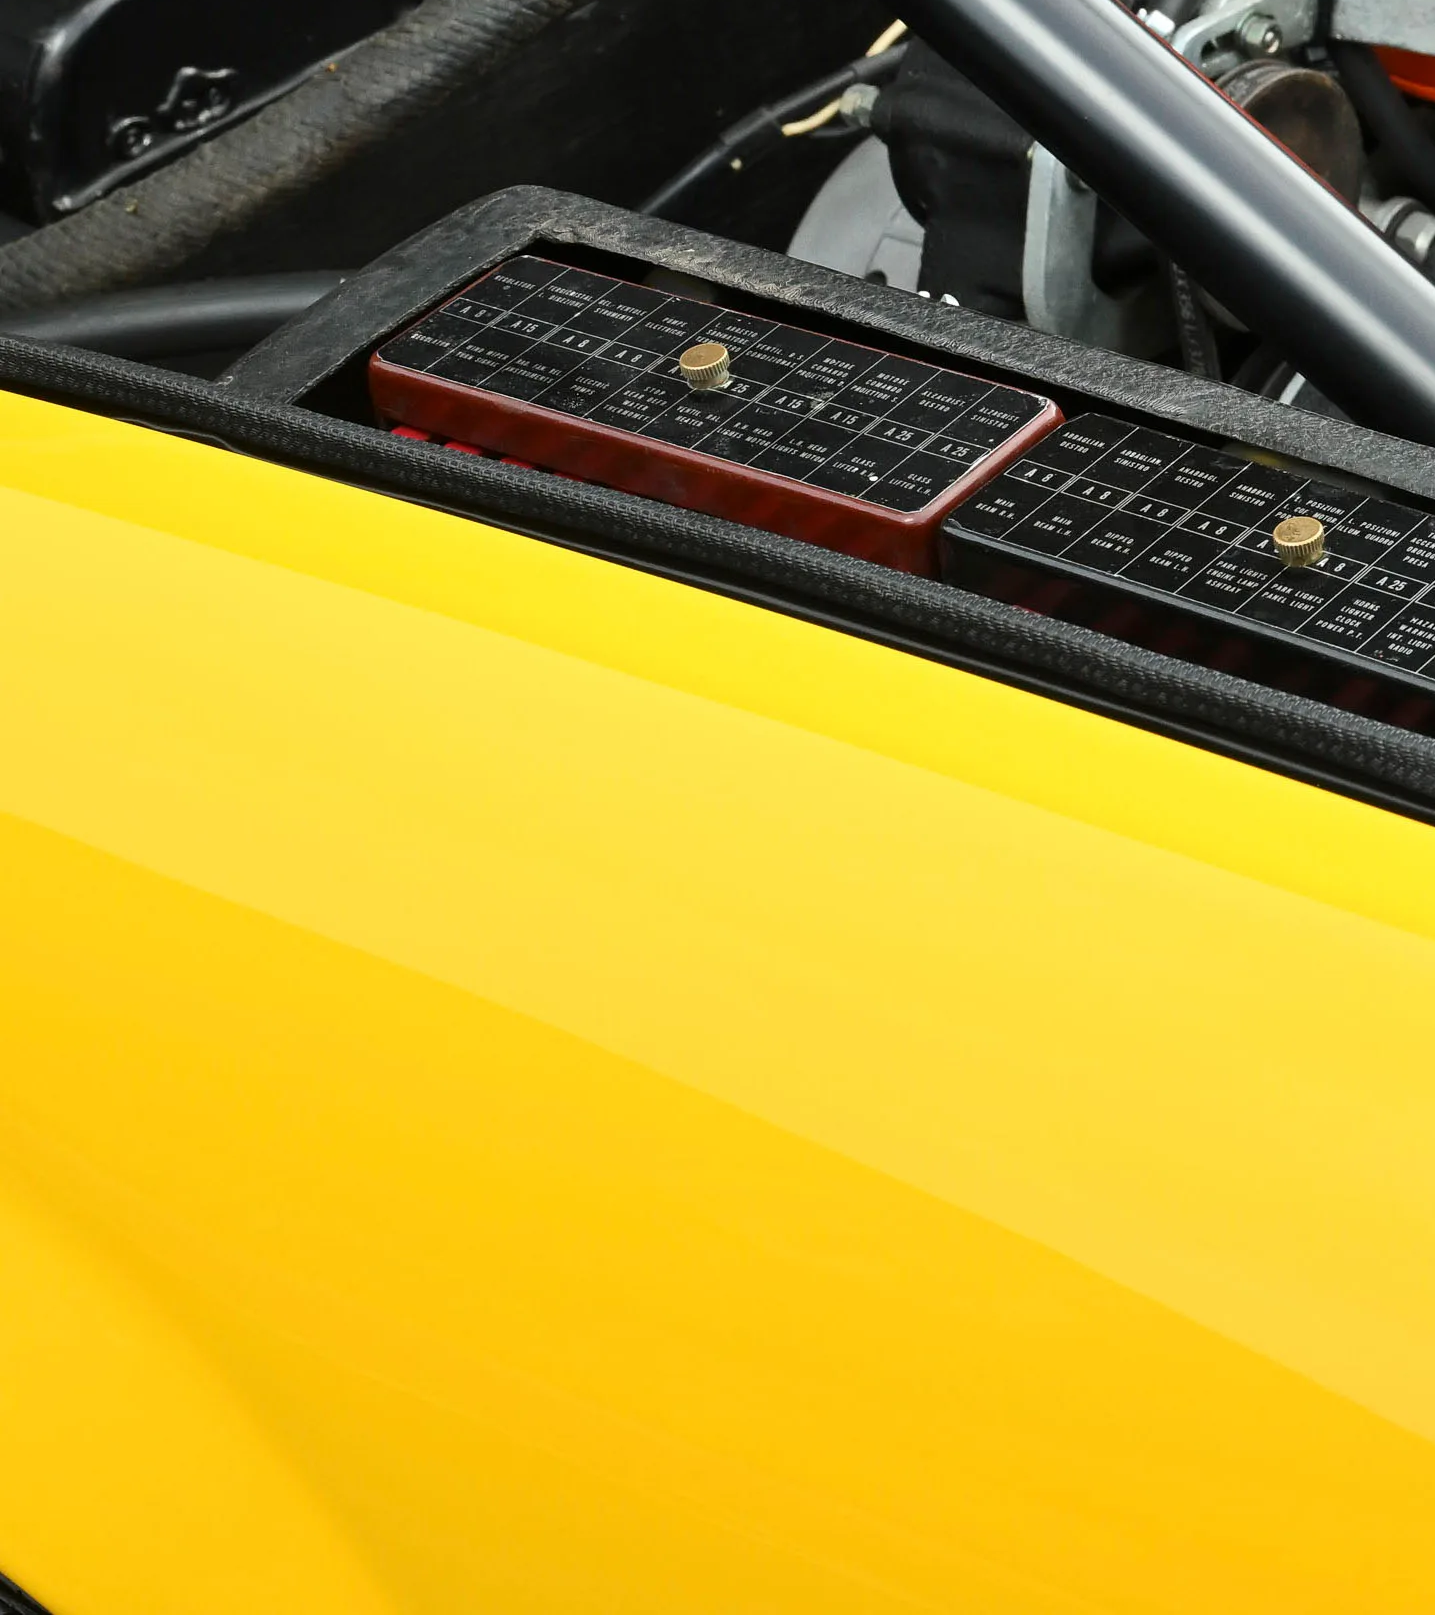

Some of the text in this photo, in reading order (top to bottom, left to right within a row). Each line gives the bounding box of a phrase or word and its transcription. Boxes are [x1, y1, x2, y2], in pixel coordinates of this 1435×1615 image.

[459, 305, 486, 317] A 8
[509, 320, 538, 332] A 15
[562, 335, 589, 347] A 8
[614, 349, 642, 362] A 8
[666, 364, 682, 374] A
[822, 357, 854, 369] MOTORE
[810, 364, 848, 377] COMANDO
[876, 372, 909, 385] MOTORE
[643, 386, 665, 395] STOP
[718, 379, 749, 393] A 25
[850, 385, 890, 400] PROIETTORI
[865, 379, 902, 393] COMANDO
[622, 399, 648, 411] WATER
[774, 395, 803, 408] A 15
[918, 399, 950, 411] DESTRO
[674, 415, 703, 426] HEATER
[829, 411, 858, 424] A 15
[970, 414, 1008, 428] SINISTRO
[752, 427, 772, 436] HEAD
[883, 427, 914, 441] A 25
[745, 436, 770, 446] MOTOR
[1059, 441, 1088, 453] DESTRO
[771, 443, 825, 462] LIGHTS MOTOR
[807, 444, 827, 452] HEAD
[939, 443, 970, 456] A 25
[850, 456, 875, 467] GLASS
[1113, 457, 1149, 471] SINISTRO
[907, 473, 931, 484] GLASS
[1024, 468, 1056, 482] A 8
[1174, 475, 1203, 487] DESTRO
[888, 478, 915, 489] LIFTER
[1082, 486, 1111, 499] A 8
[1229, 492, 1265, 506] SINISTRO
[994, 498, 1014, 507] MAIN
[1305, 500, 1344, 515] POSIZIONI
[975, 503, 1016, 519] BEAM R.H.
[1139, 503, 1168, 517] A 8
[1051, 515, 1072, 525] MAIN
[1033, 520, 1073, 536] BEAM L.H.
[1197, 521, 1227, 535] A 8
[1359, 521, 1400, 537] POSIZIONI
[1104, 532, 1133, 544] DIPPED
[1256, 539, 1269, 548] A
[1364, 533, 1393, 545] QUADRO
[1090, 538, 1132, 554] BEAM R.H.
[1163, 550, 1192, 562] DIPPED
[1402, 555, 1428, 567] PRESA
[1149, 556, 1190, 572] BEAM L.H.
[1216, 560, 1267, 580] PARK LIGHTS
[1315, 557, 1345, 572] A 8
[1206, 568, 1258, 587] ENGINE LAMP
[1375, 576, 1407, 591] A 25
[1205, 579, 1241, 593] ASHTRAY
[1270, 583, 1323, 603] PARK LIGHTS
[1261, 591, 1314, 611] PANEL LIGHT
[1353, 599, 1380, 611] HORNS
[1340, 606, 1374, 620] LIGHTER
[1335, 615, 1361, 627] CLOCK
[1315, 619, 1364, 639] POWER P.T.
[1388, 643, 1413, 654] RADIO
[1407, 638, 1432, 649] LIGHT
